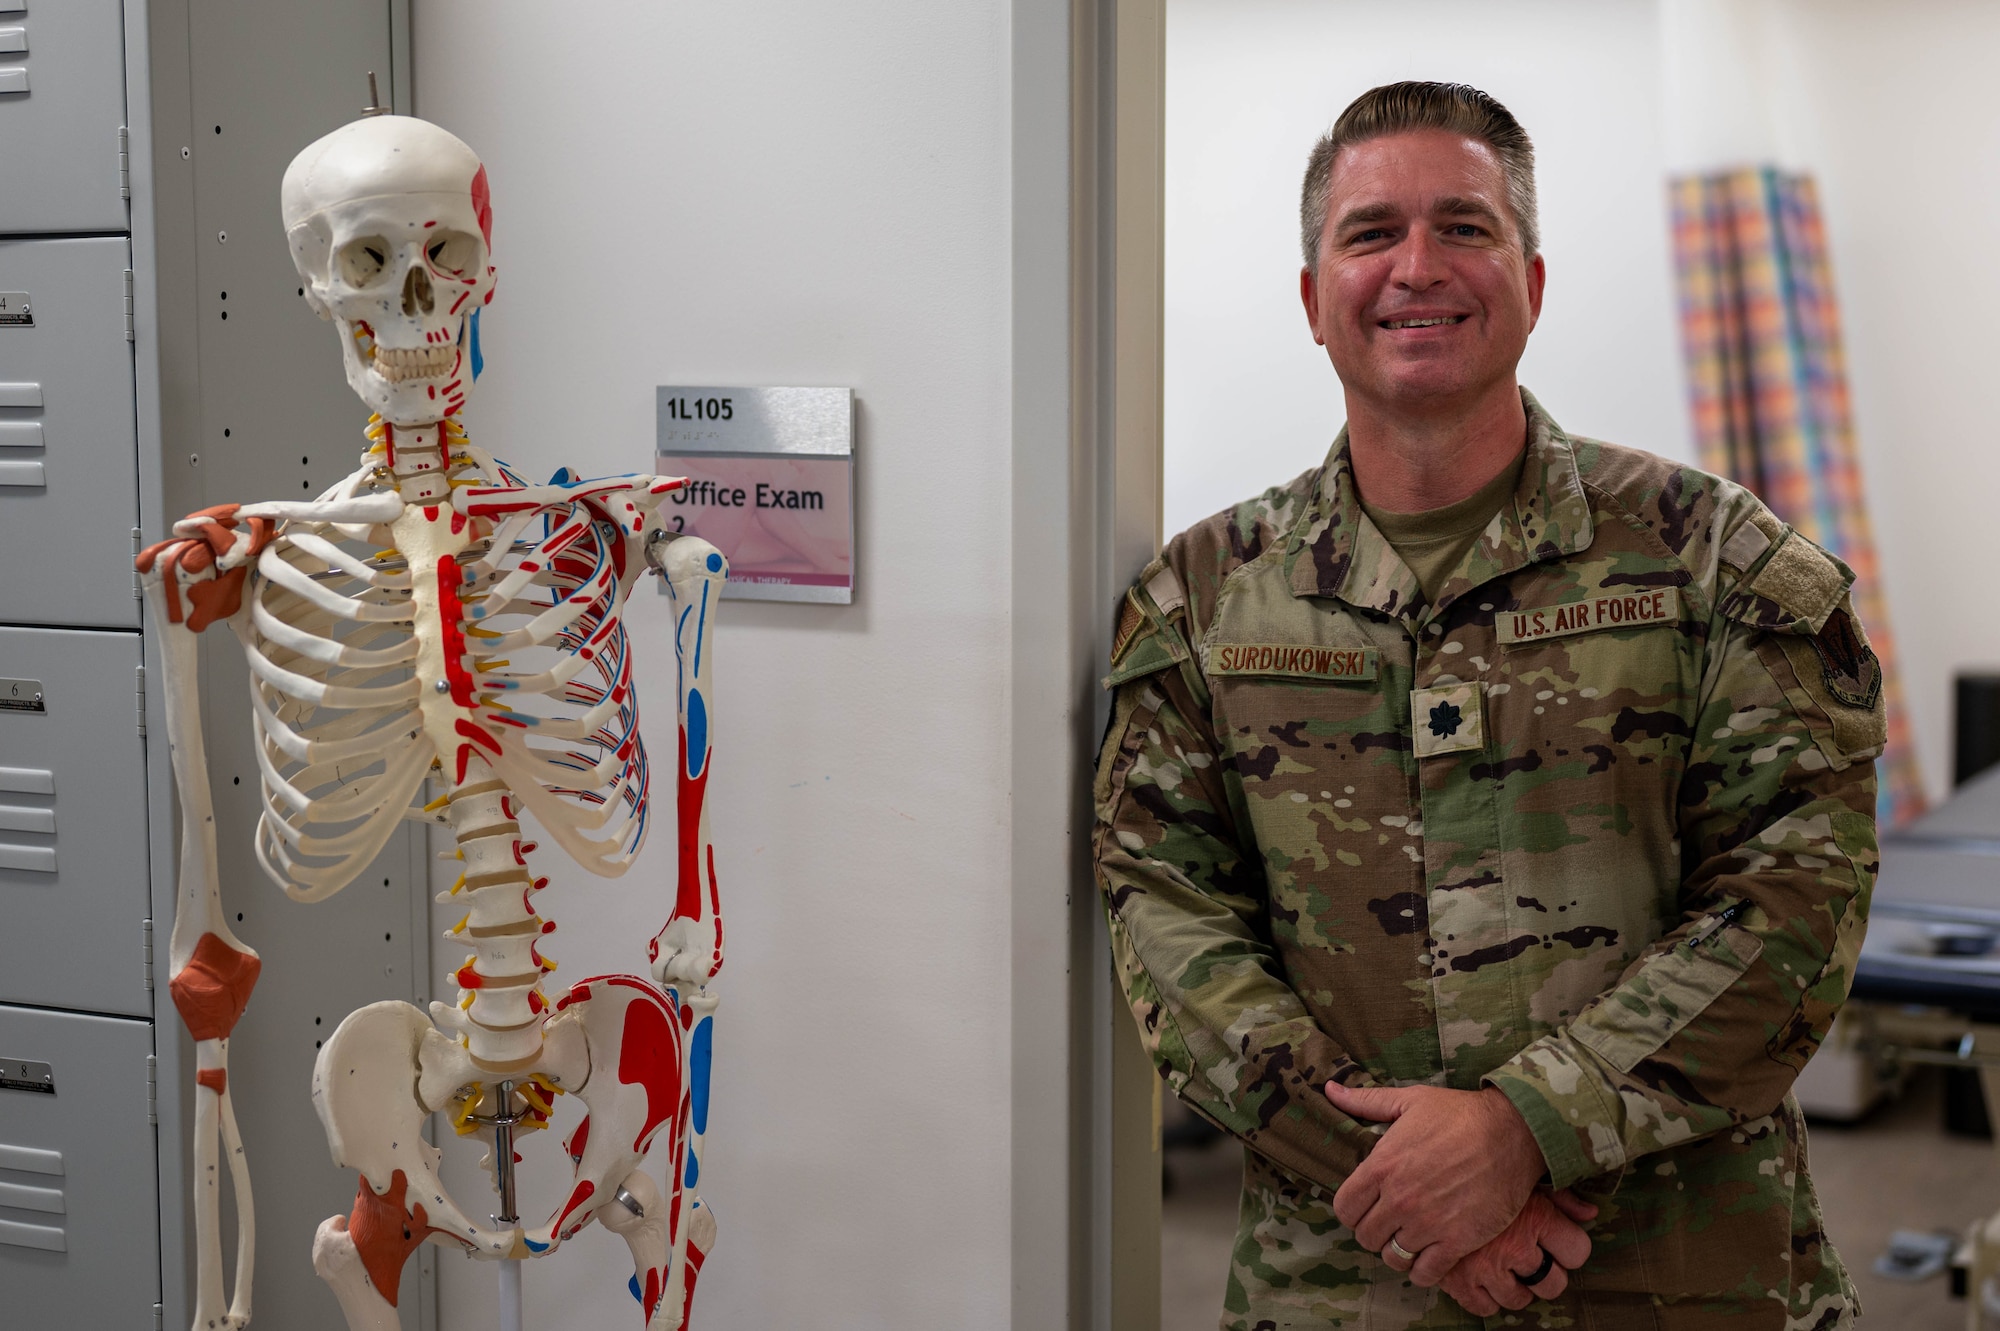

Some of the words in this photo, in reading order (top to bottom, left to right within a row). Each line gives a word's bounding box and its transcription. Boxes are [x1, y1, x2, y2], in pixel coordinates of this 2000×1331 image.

[0, 297, 6, 310] 4
[667, 397, 733, 420] 1L105
[671, 481, 746, 507] Office
[755, 483, 824, 510] Exam
[671, 515, 685, 533] 2
[728, 575, 753, 584] YSICAL
[757, 576, 792, 585] THERAPY
[1513, 611, 1550, 639] U.S.
[1555, 604, 1590, 632] AIR
[1596, 592, 1666, 625] FORCE
[1220, 646, 1365, 676] SURDUKOWSKI
[12, 683, 18, 697] 6
[22, 1064, 28, 1078] 8
